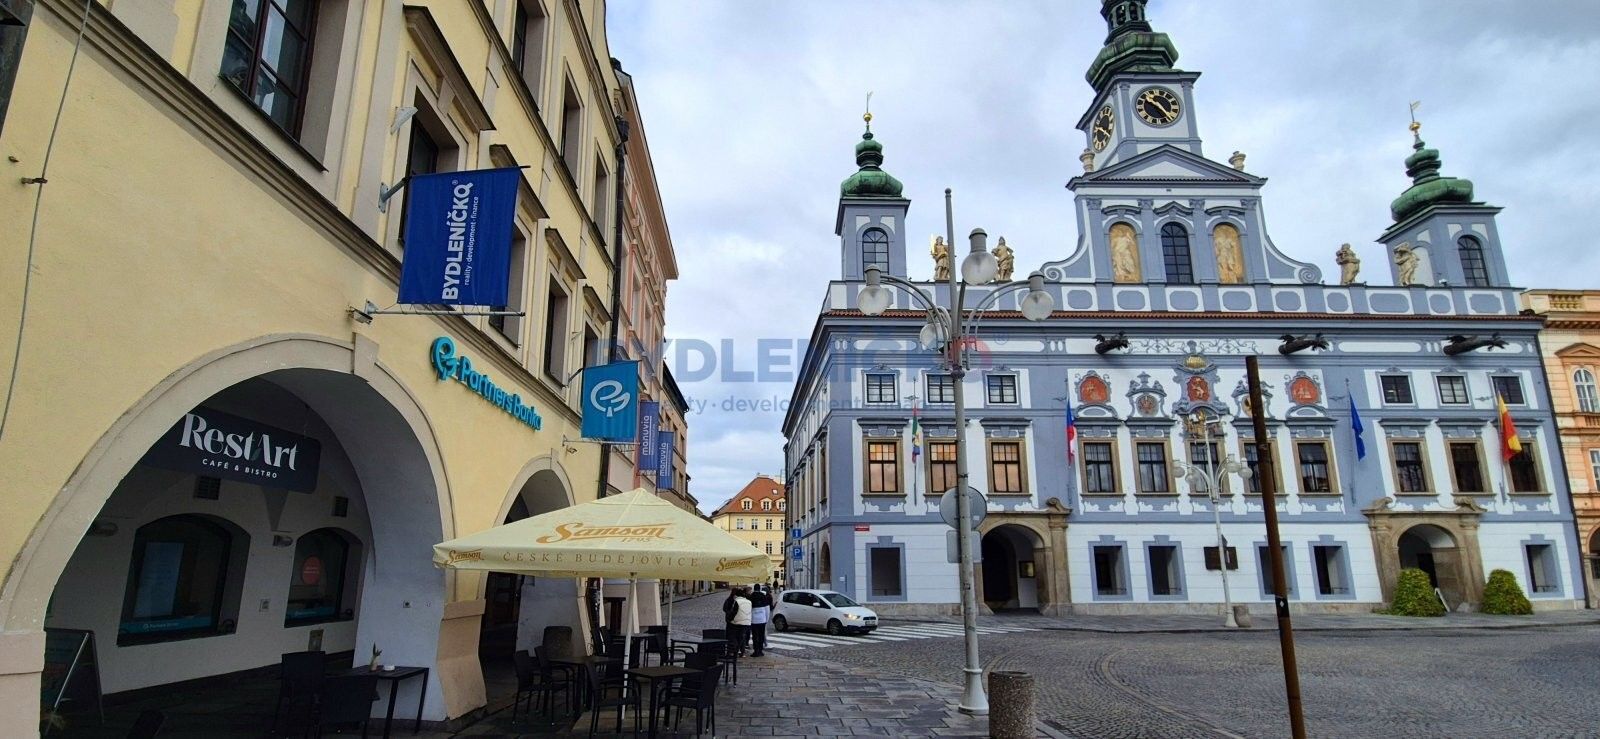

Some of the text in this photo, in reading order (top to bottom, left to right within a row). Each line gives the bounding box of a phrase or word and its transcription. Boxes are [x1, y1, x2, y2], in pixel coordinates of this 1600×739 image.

[464, 197, 479, 285] reality development finance
[458, 356, 542, 431] Partners Banka
[179, 413, 299, 471] RestArt
[202, 458, 229, 469] CAFÉ
[244, 466, 278, 479] BISTRO
[536, 522, 675, 544] Samson
[446, 549, 485, 564] Samson
[503, 552, 563, 562] ČESKÉ
[716, 557, 754, 572] Samson
